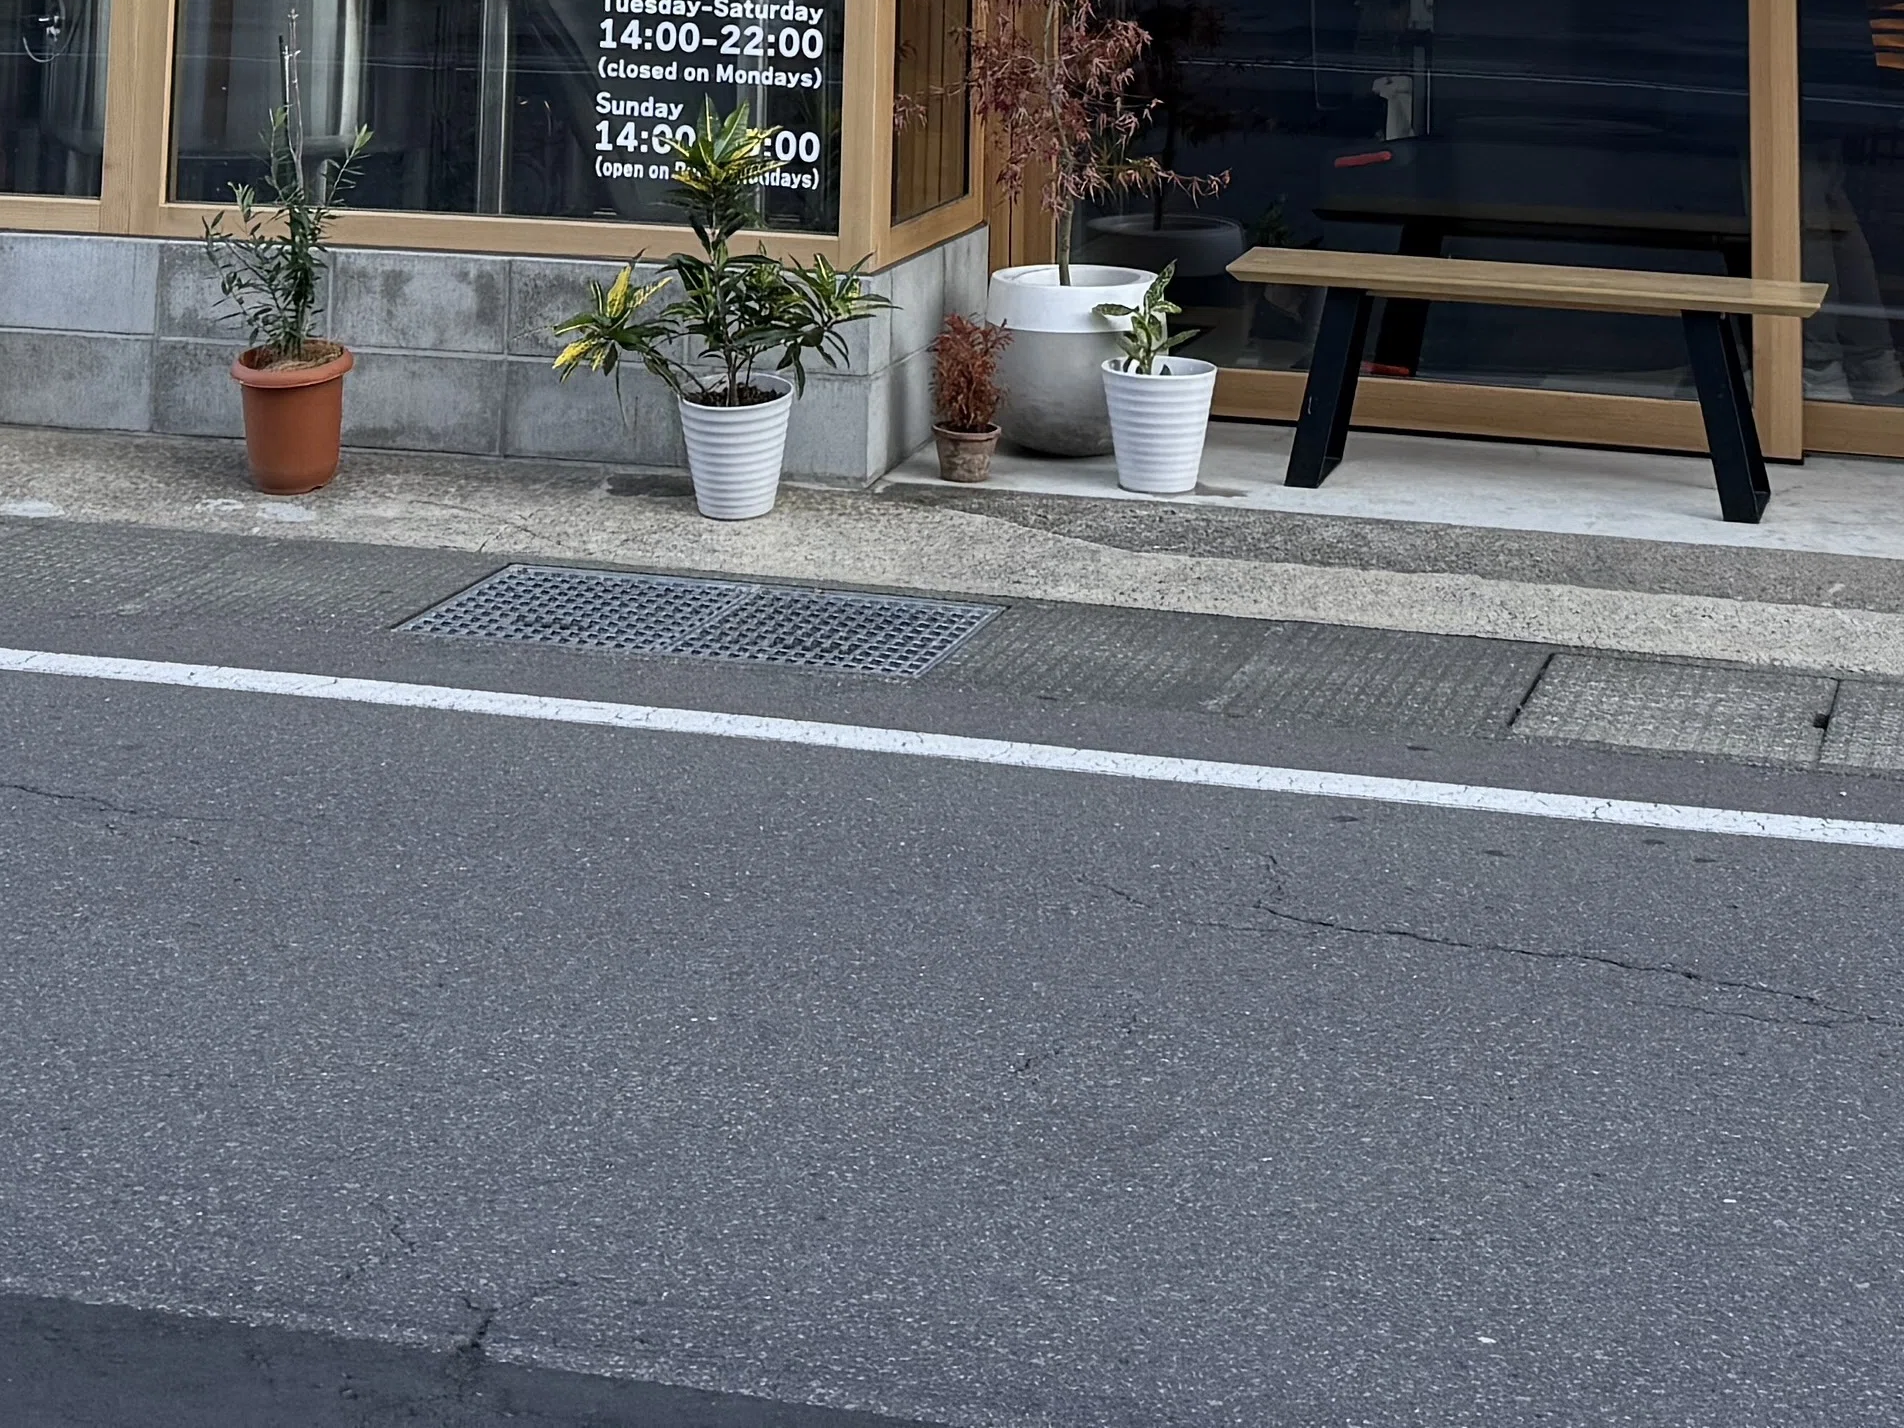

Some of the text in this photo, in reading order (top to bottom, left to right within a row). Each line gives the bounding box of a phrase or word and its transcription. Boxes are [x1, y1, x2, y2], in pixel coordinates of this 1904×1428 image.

[599, 18, 824, 59] 14:00-22:00
[597, 55, 823, 89] (closed on Mondays)
[595, 92, 684, 121] Sunday
[595, 155, 646, 179] (open
[648, 163, 670, 180] on
